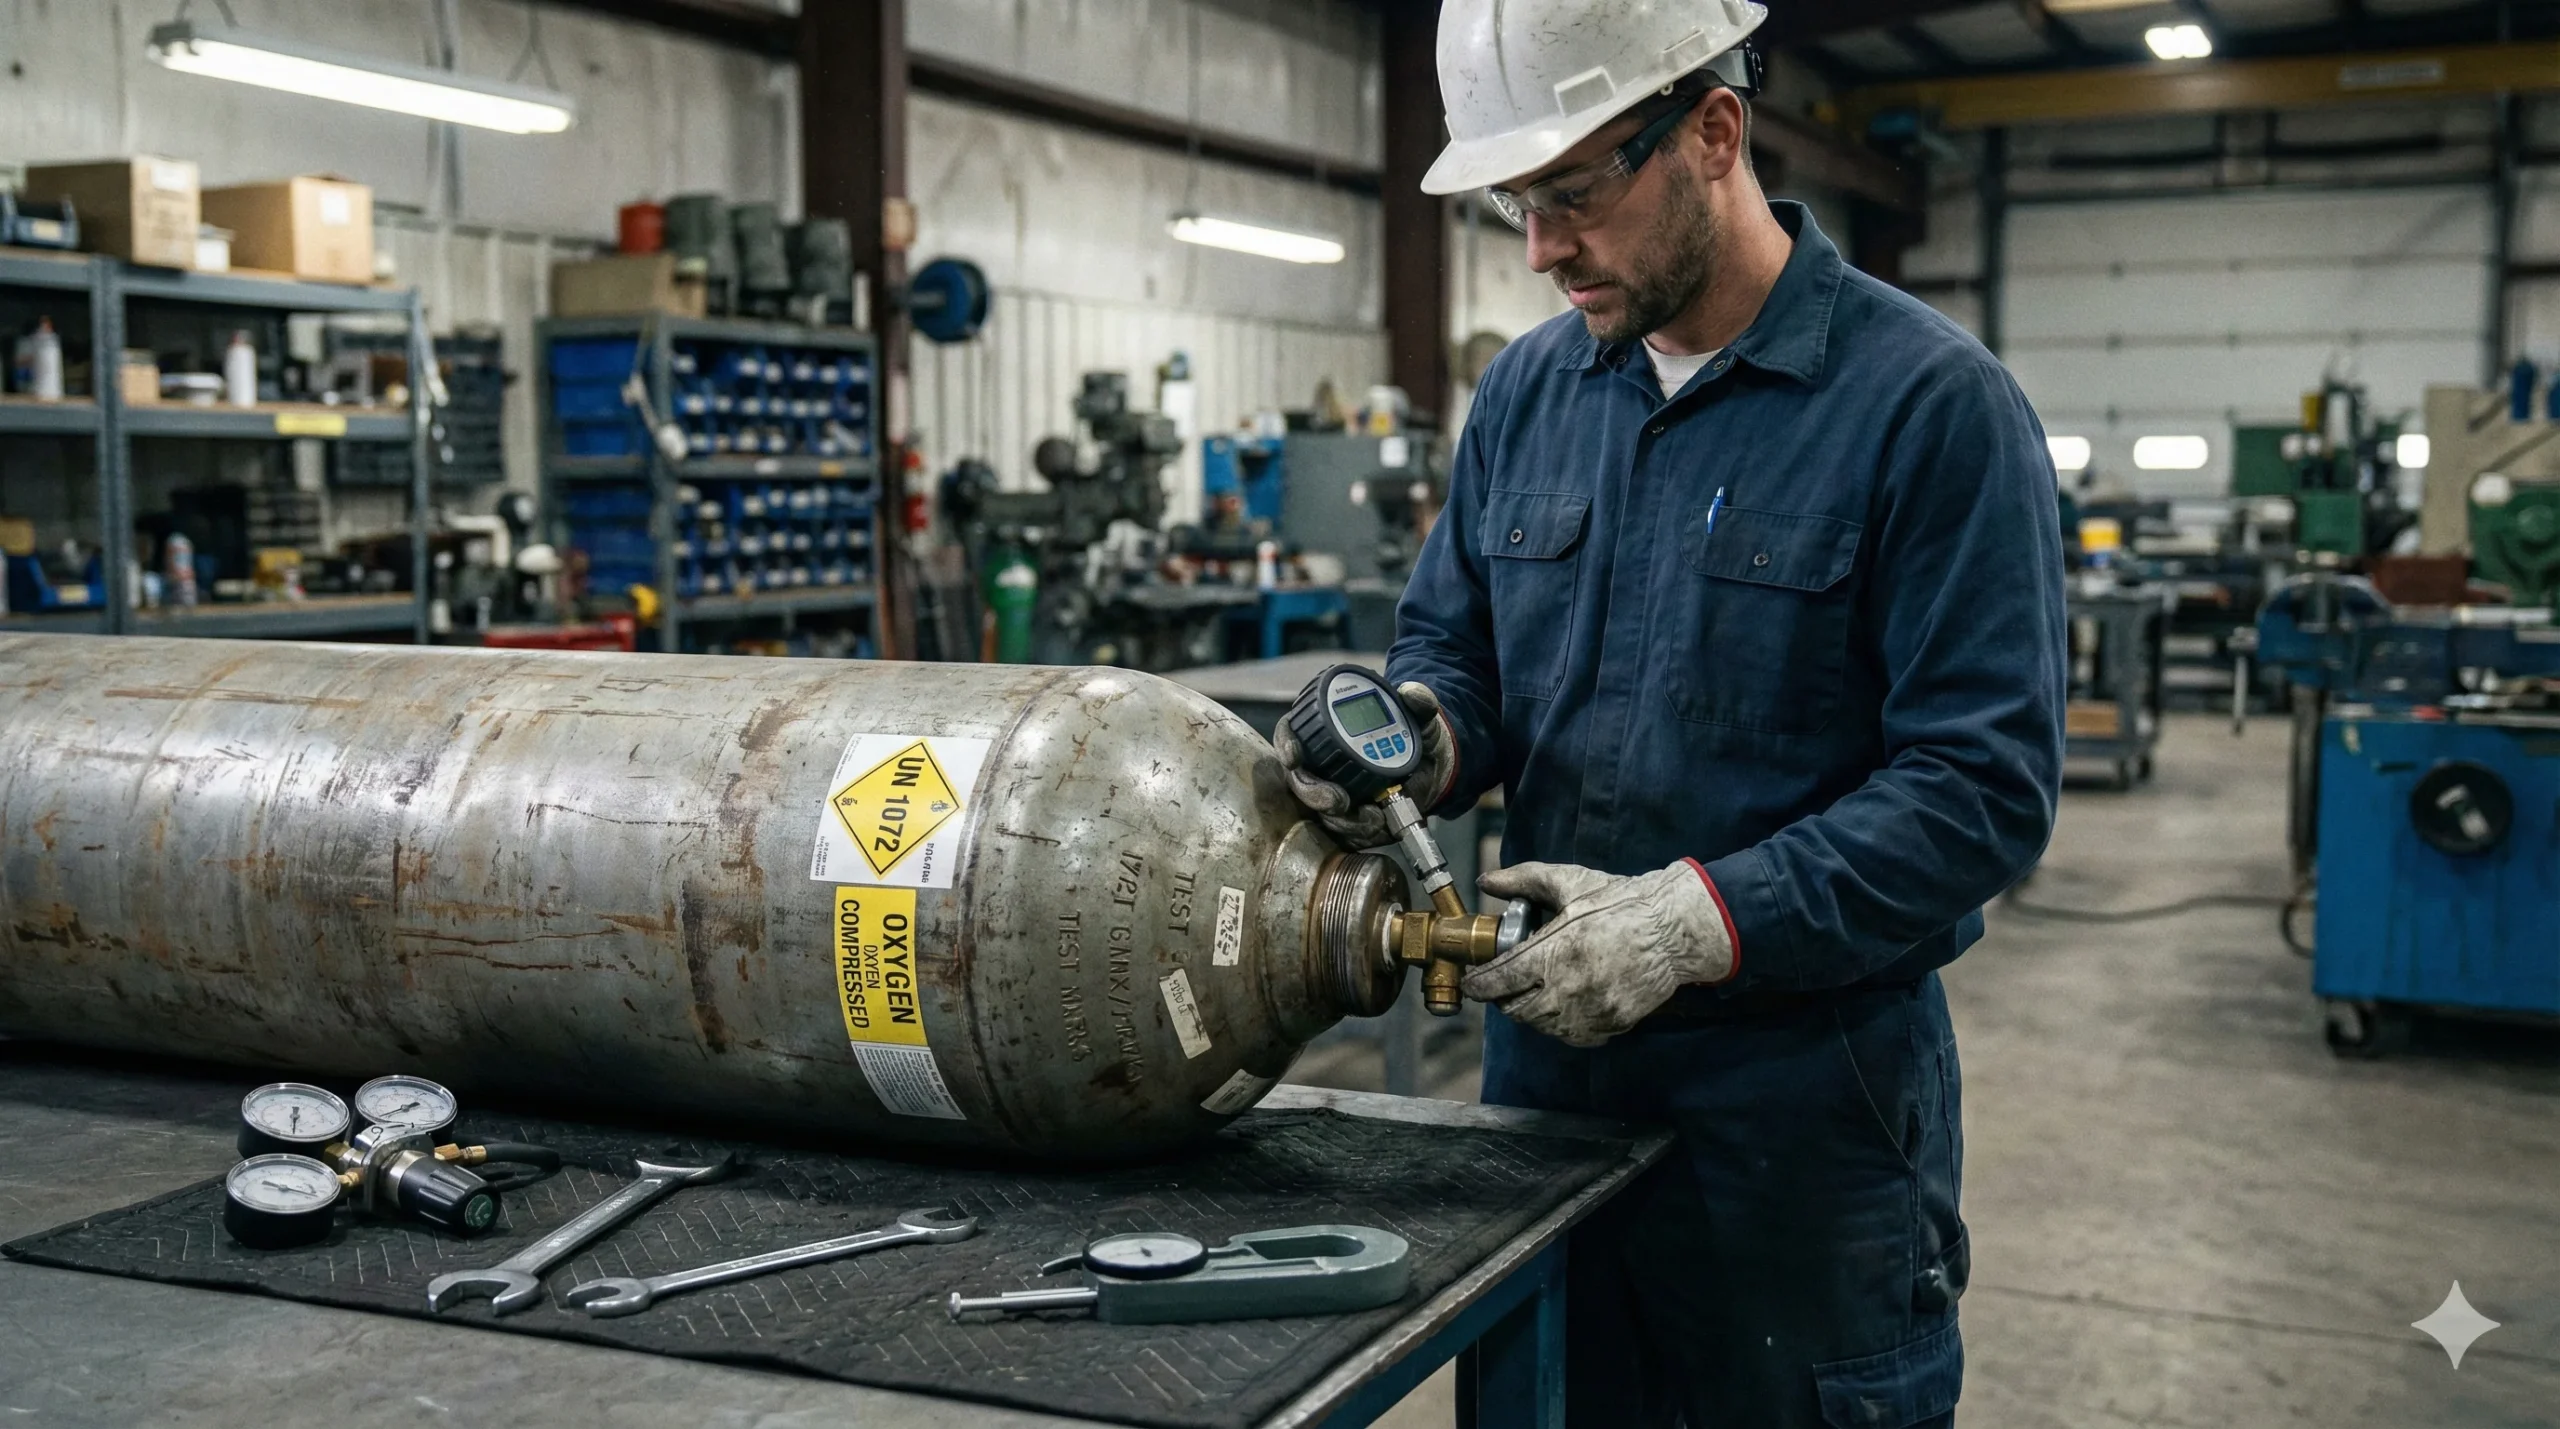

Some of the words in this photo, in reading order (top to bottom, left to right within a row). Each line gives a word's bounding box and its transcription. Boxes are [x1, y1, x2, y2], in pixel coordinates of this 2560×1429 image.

[890, 756, 925, 787] UN
[874, 793, 911, 854] 1072
[1167, 871, 1197, 937] TEST
[840, 898, 870, 1030] COMPRESSED
[863, 944, 881, 990] OXYEN
[883, 912, 917, 1026] OXYGEN
[1058, 910, 1081, 973] TEST
